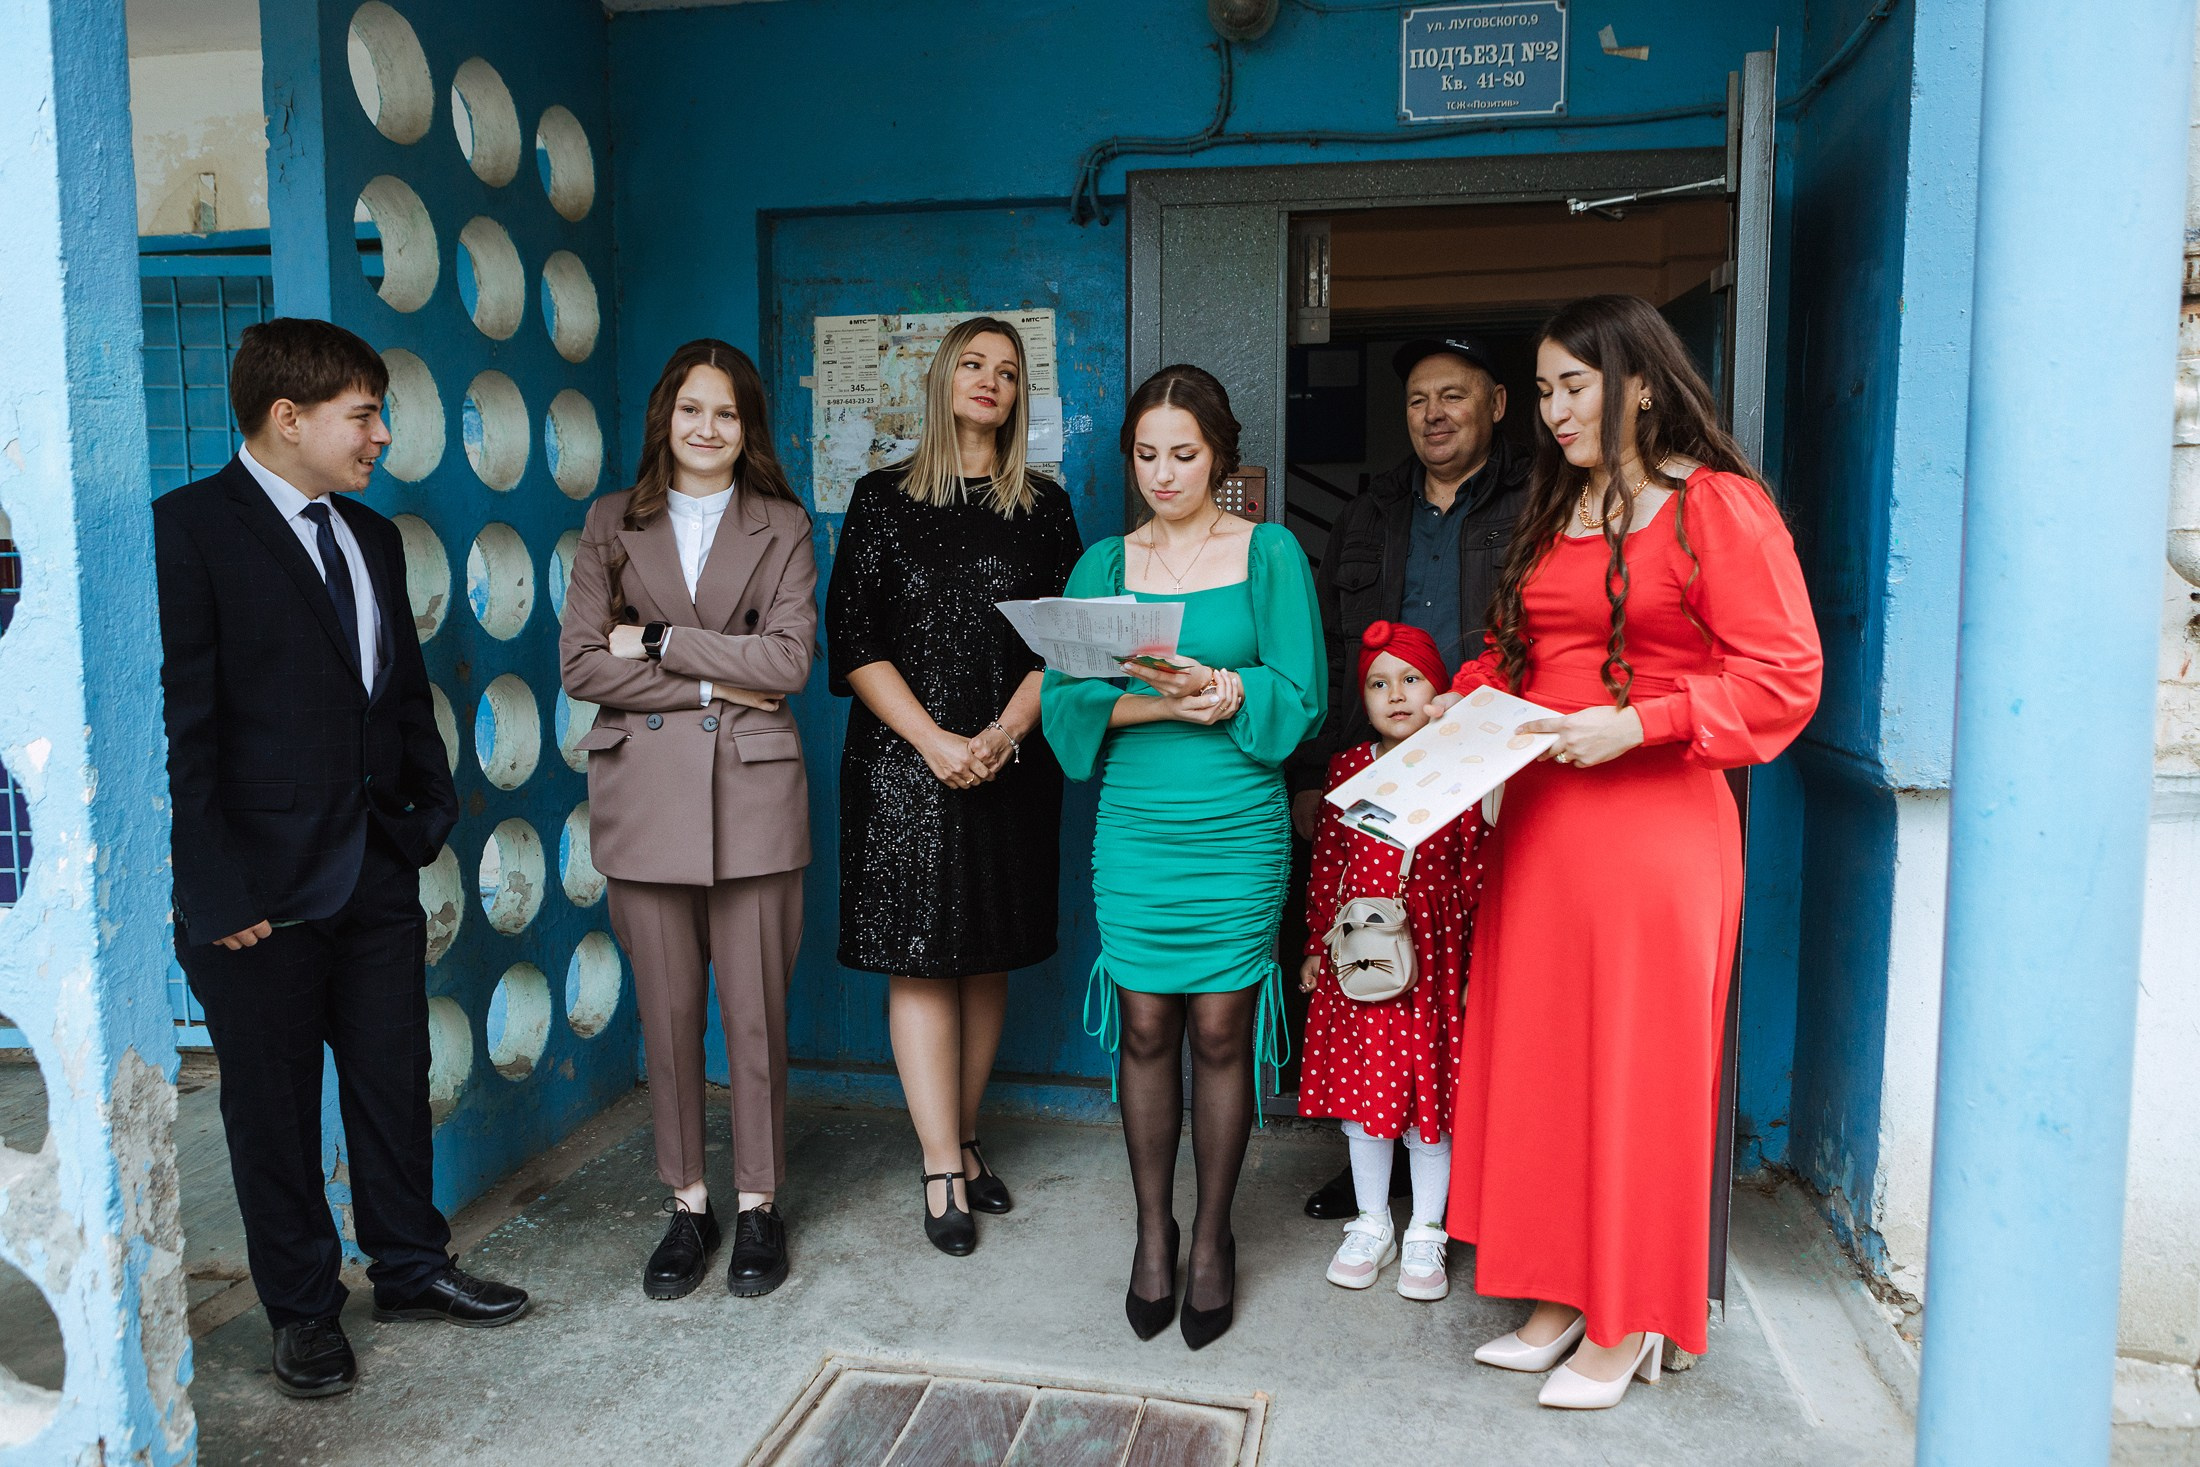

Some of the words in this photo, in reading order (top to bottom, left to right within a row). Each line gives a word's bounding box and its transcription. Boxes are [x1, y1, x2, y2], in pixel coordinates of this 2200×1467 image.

[1426, 22, 1445, 33] ул.
[1448, 13, 1539, 31] ЛУГОВСКОГО,9
[1409, 43, 1515, 72] ПОДЪЕЗД
[1521, 40, 1559, 63] №2
[1441, 74, 1468, 92] Кв.
[1476, 70, 1526, 90] 41-80
[850, 383, 866, 392] 345
[826, 397, 875, 406] 8-987-643-23-23
